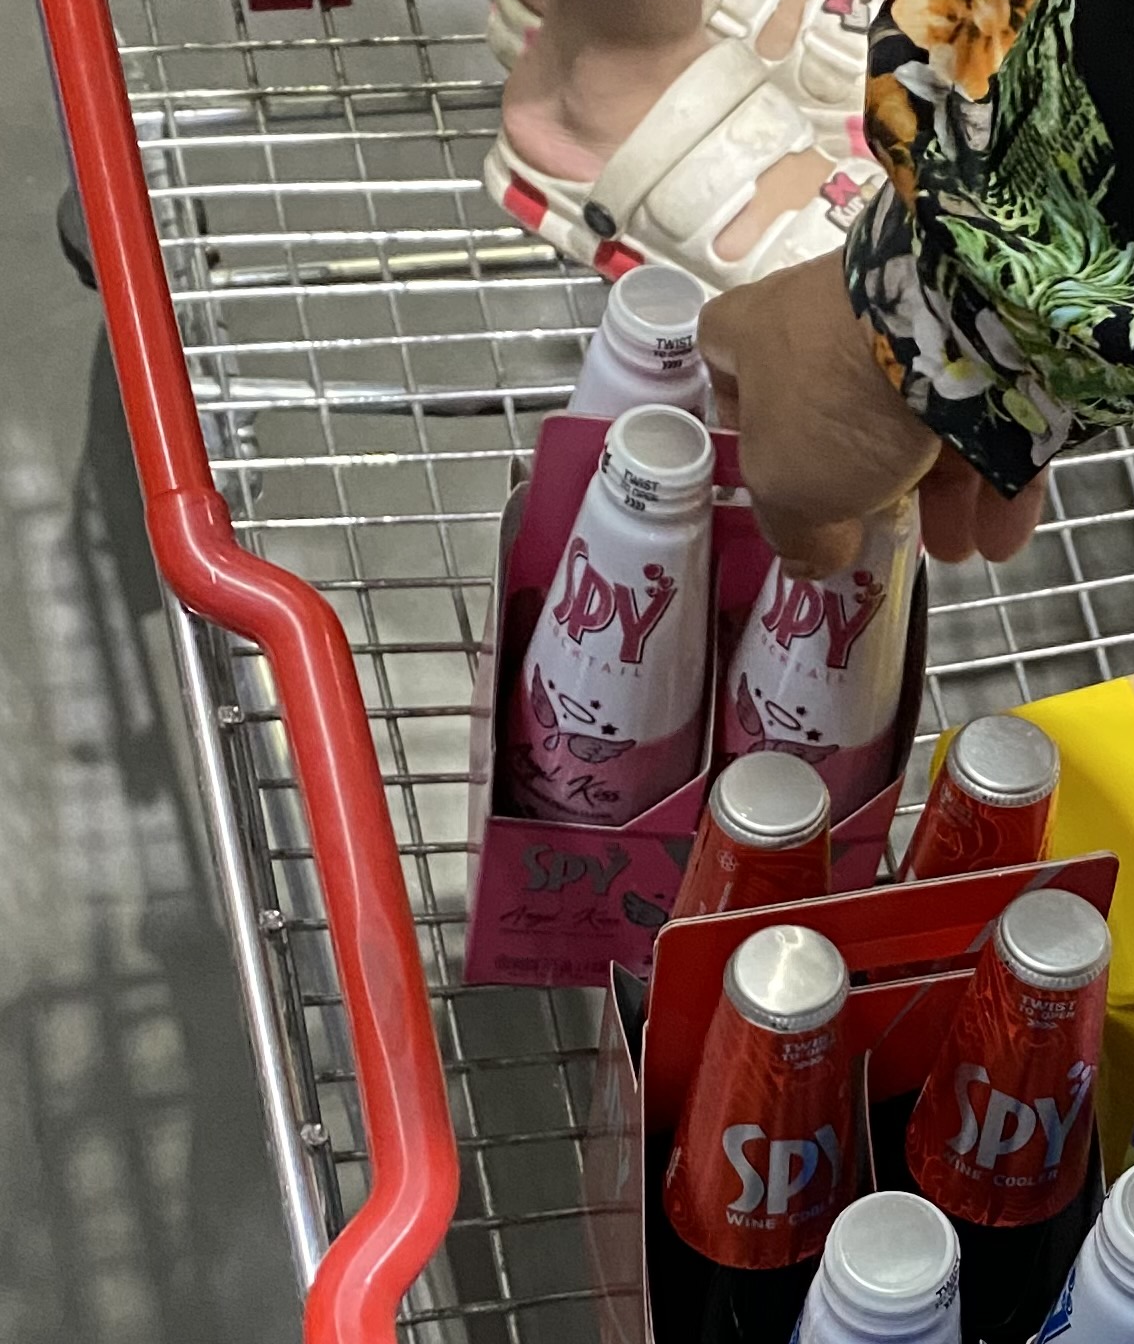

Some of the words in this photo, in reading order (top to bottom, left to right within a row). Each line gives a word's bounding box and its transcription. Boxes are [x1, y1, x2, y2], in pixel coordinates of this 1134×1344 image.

[655, 335, 693, 350] TWIST
[624, 468, 660, 492] TWIST
[552, 536, 677, 665] SPY
[761, 561, 889, 670] SPY
[521, 841, 633, 897] SPY
[1020, 994, 1077, 1013] TWIST
[947, 1060, 1094, 1169] SPY
[727, 1212, 777, 1231] WINE
